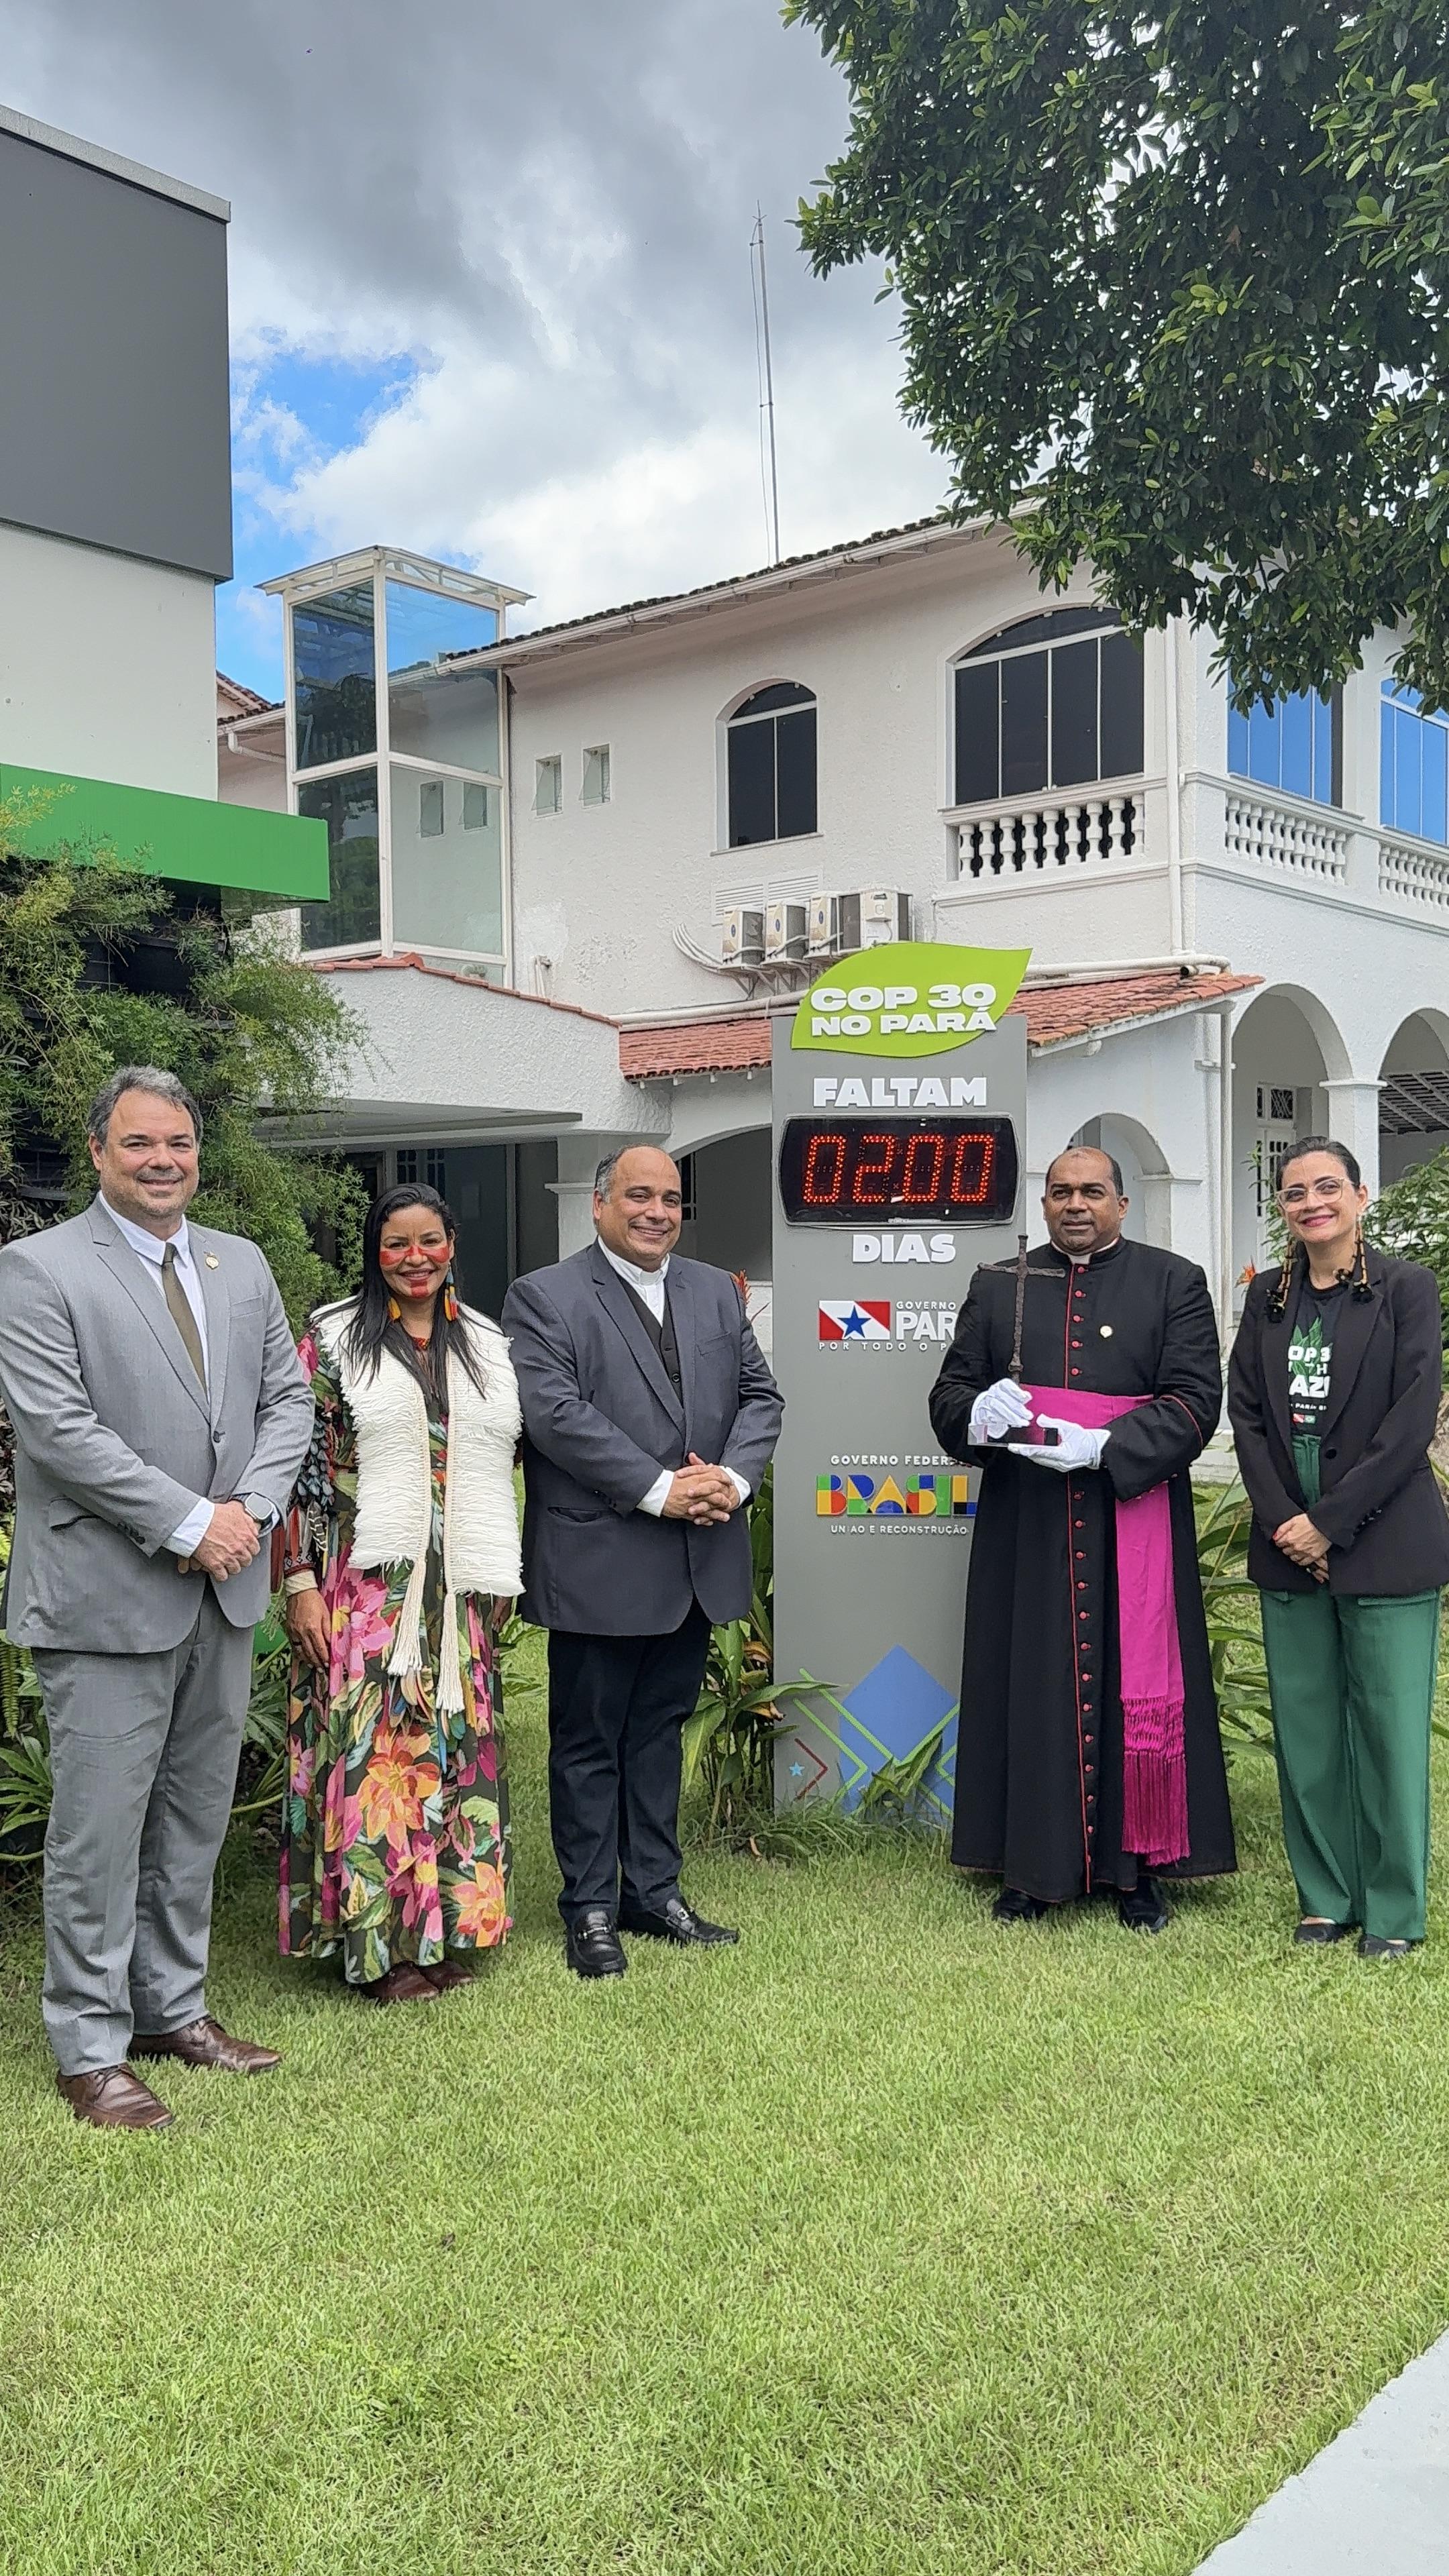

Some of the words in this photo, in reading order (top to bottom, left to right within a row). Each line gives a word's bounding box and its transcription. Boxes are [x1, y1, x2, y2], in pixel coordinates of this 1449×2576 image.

[810, 987, 918, 1012] COP
[928, 983, 997, 1008] 30
[812, 1015, 871, 1036] NO
[880, 1006, 997, 1034] PARÁ
[813, 1077, 987, 1108] FALTAM
[803, 1133, 994, 1203] 0200
[852, 1234, 956, 1263] DIAS
[896, 1301, 956, 1310] GOVERNO
[896, 1310, 958, 1341] PAR
[819, 1342, 850, 1350] POR
[862, 1342, 907, 1351] TODO
[919, 1342, 928, 1351] O
[940, 1343, 947, 1351] P
[830, 1454, 899, 1466] GOVERNO
[904, 1454, 955, 1466] FEDER
[816, 1474, 977, 1516] BRASIL
[869, 1525, 875, 1534] E
[879, 1524, 968, 1536] RECONSTRUÇÃO
